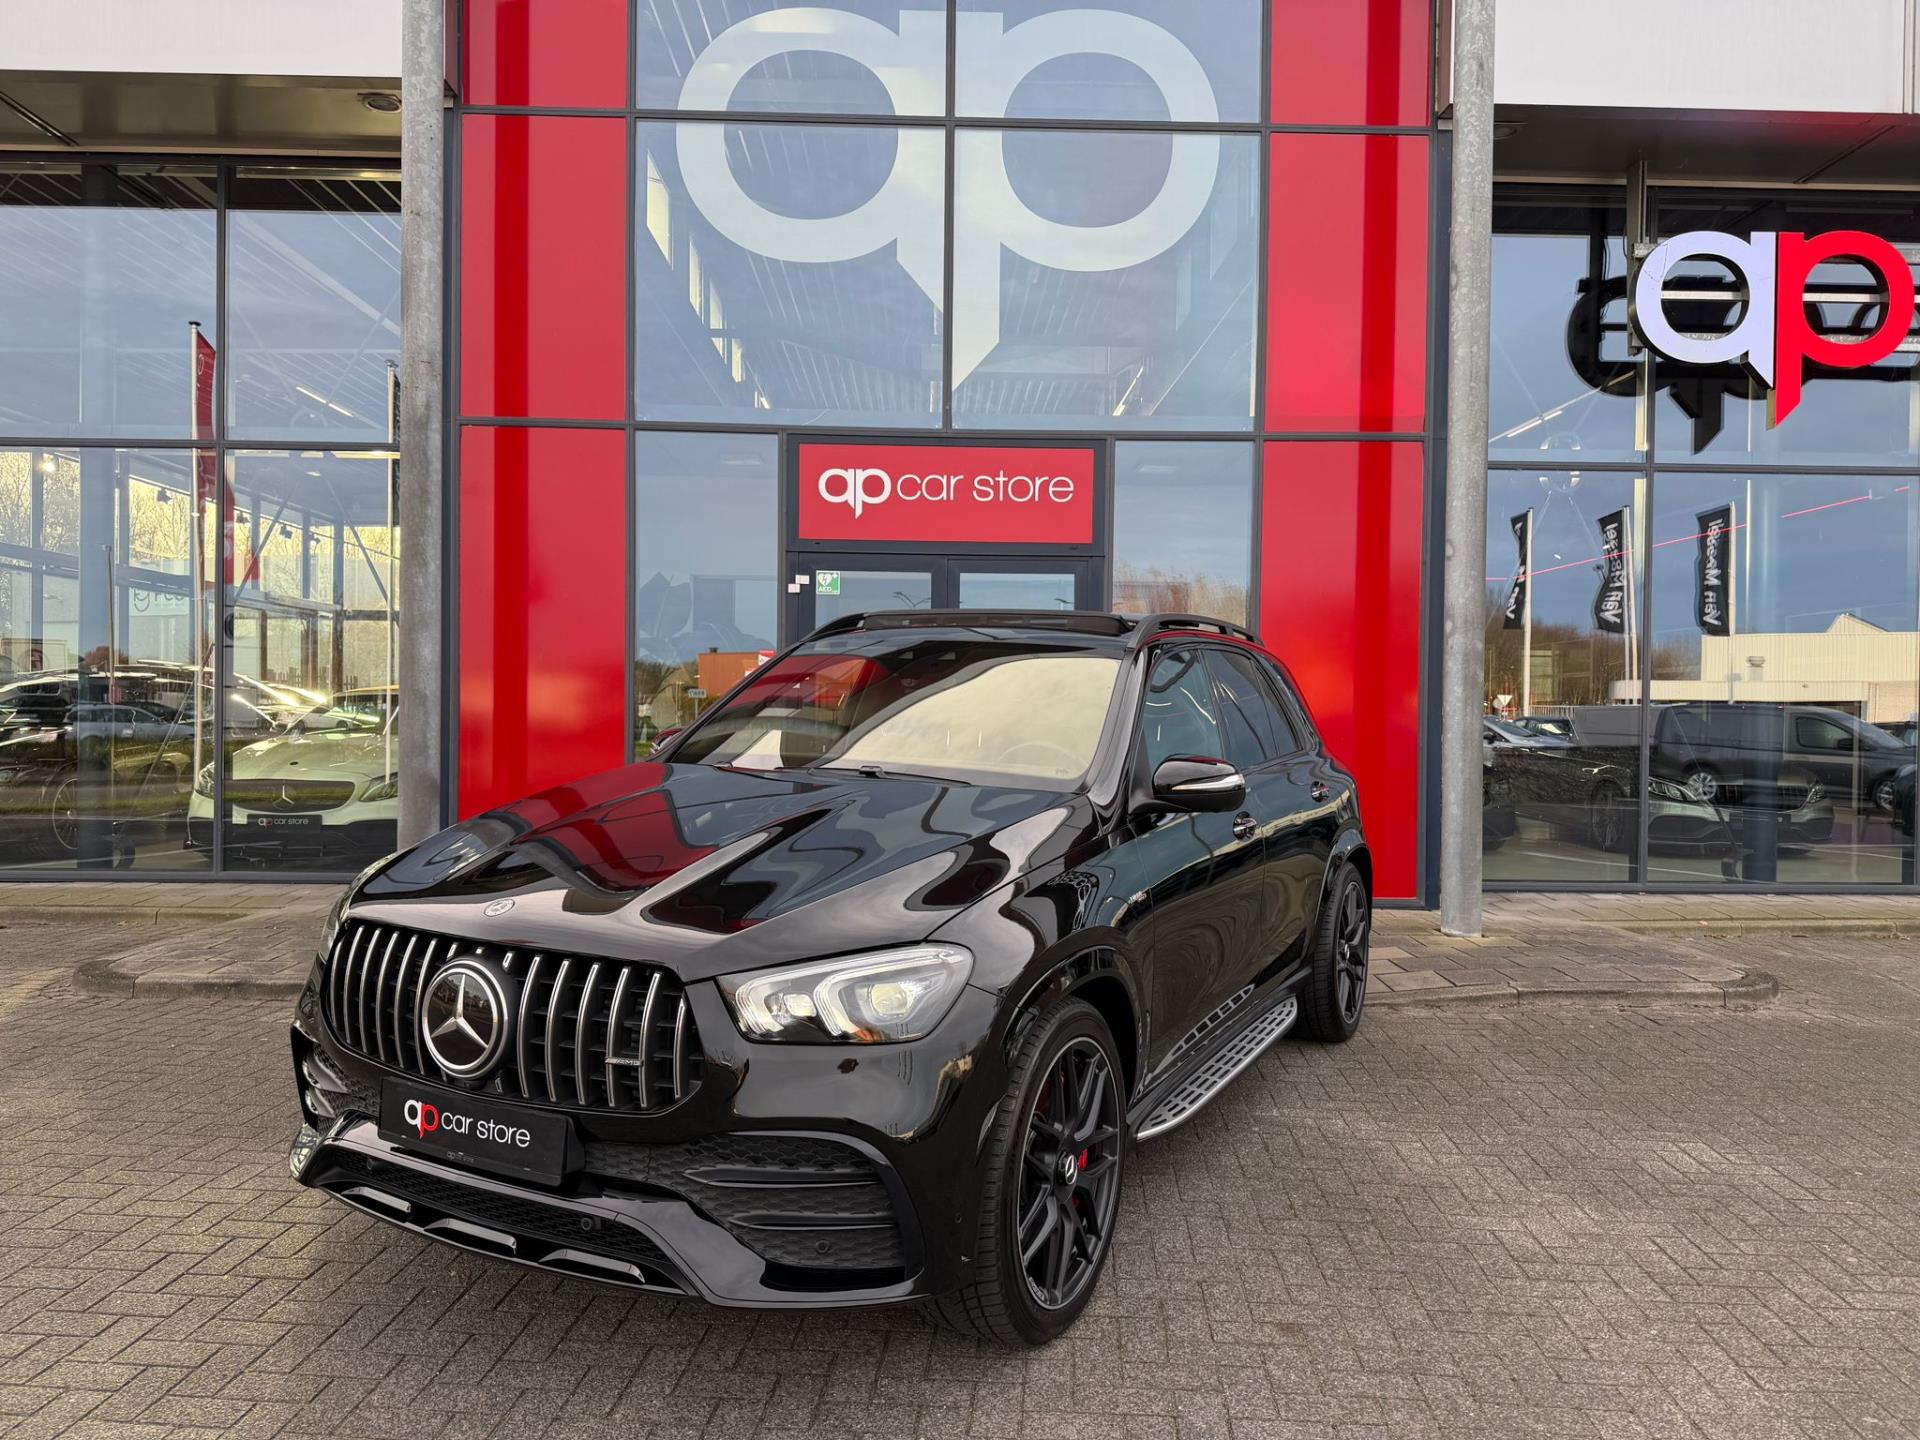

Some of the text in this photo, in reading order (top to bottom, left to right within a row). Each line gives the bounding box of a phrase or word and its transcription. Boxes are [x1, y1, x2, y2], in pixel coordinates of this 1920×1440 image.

[897, 473, 964, 502] car
[972, 469, 1074, 503] store
[274, 817, 287, 825] car
[288, 817, 309, 825] store
[441, 1112, 474, 1135] car
[476, 1119, 531, 1148] store
